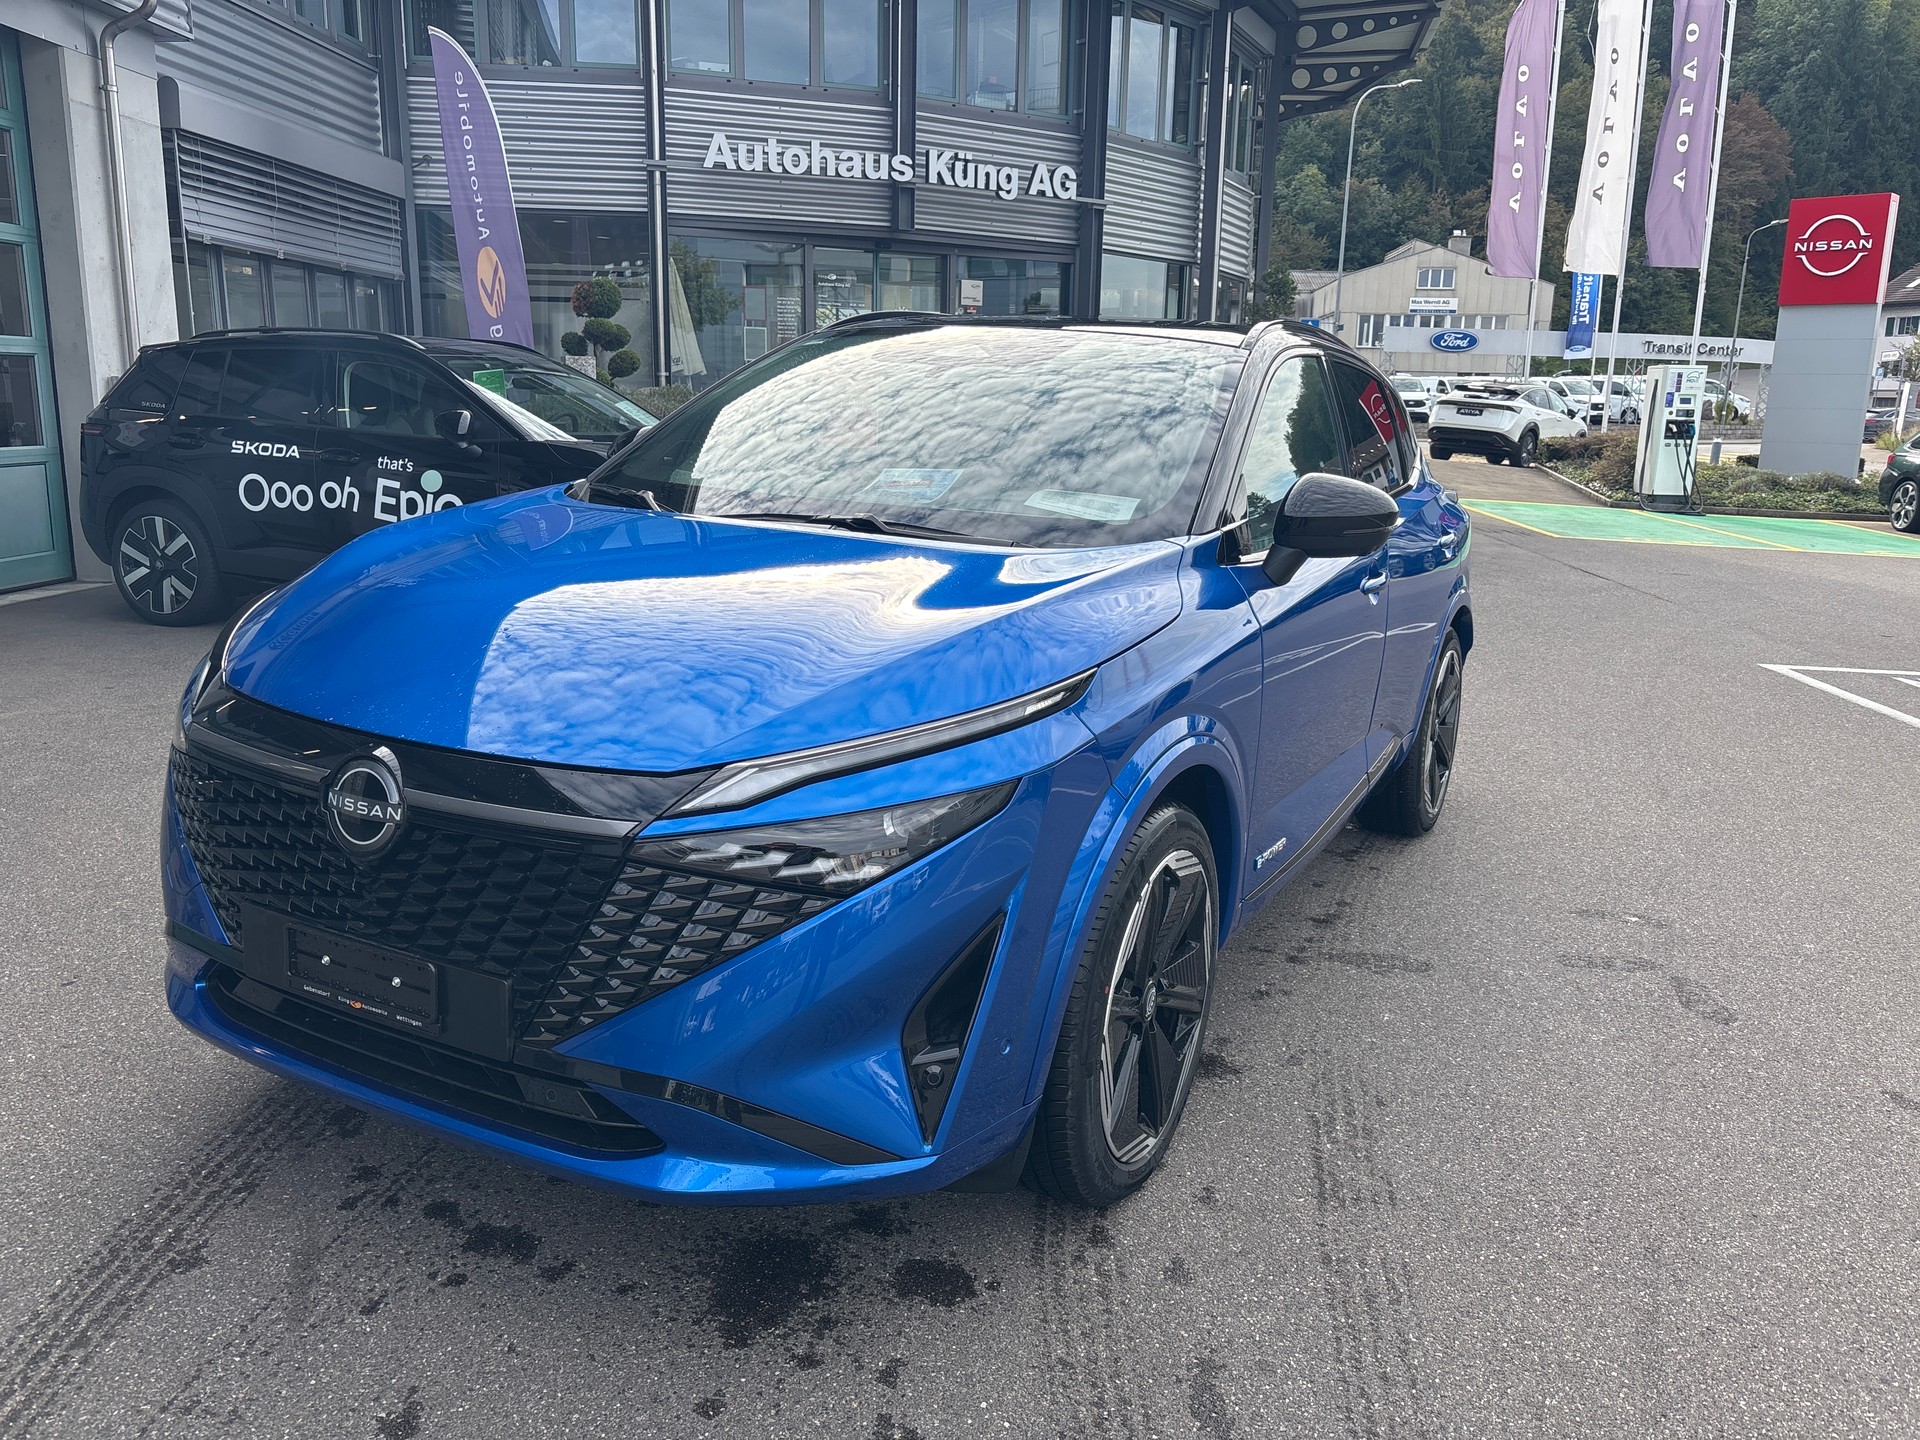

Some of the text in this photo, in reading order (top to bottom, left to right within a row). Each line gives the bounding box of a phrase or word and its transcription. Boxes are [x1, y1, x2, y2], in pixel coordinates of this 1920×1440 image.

[702, 131, 1079, 201] Autohaus Küng AG
[1794, 239, 1873, 252] NISSAN
[1440, 333, 1470, 347] Ford
[1644, 340, 1744, 356] Transit Center
[377, 456, 414, 472] that's
[238, 473, 314, 512] Ooo
[319, 476, 360, 513] oh
[328, 791, 402, 821] NISSAN
